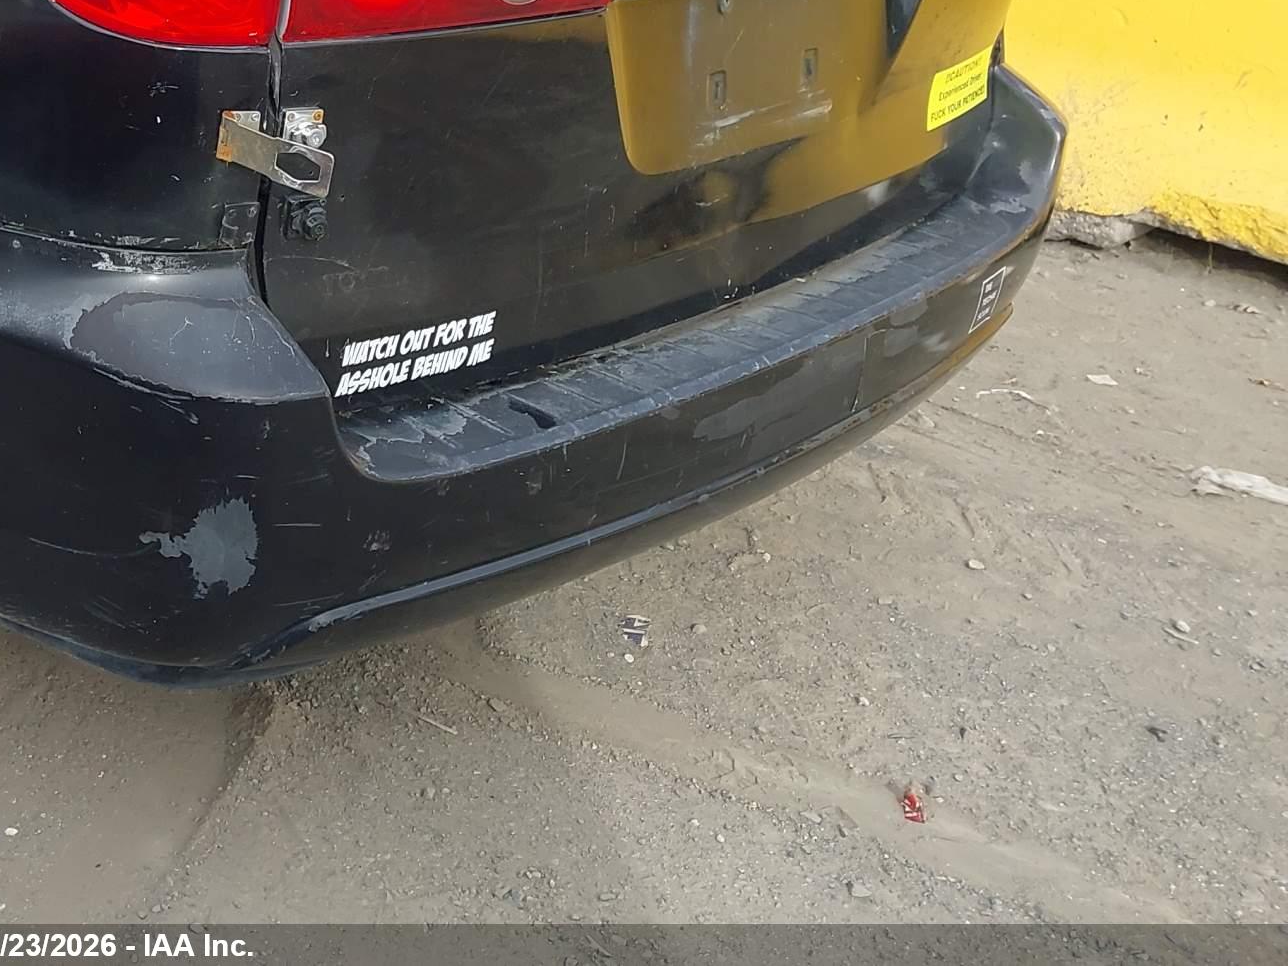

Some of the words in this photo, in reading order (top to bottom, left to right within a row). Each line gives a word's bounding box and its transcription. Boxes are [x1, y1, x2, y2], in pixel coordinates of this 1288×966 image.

[930, 108, 947, 124] FUCK
[947, 100, 962, 114] YOUR
[342, 334, 400, 367] WATCH
[400, 326, 435, 355] OUT
[433, 318, 467, 347] FOR
[468, 310, 497, 339] THE
[335, 359, 412, 397] ASSHOLE
[411, 346, 470, 380] BEHIND
[467, 338, 495, 366] ME
